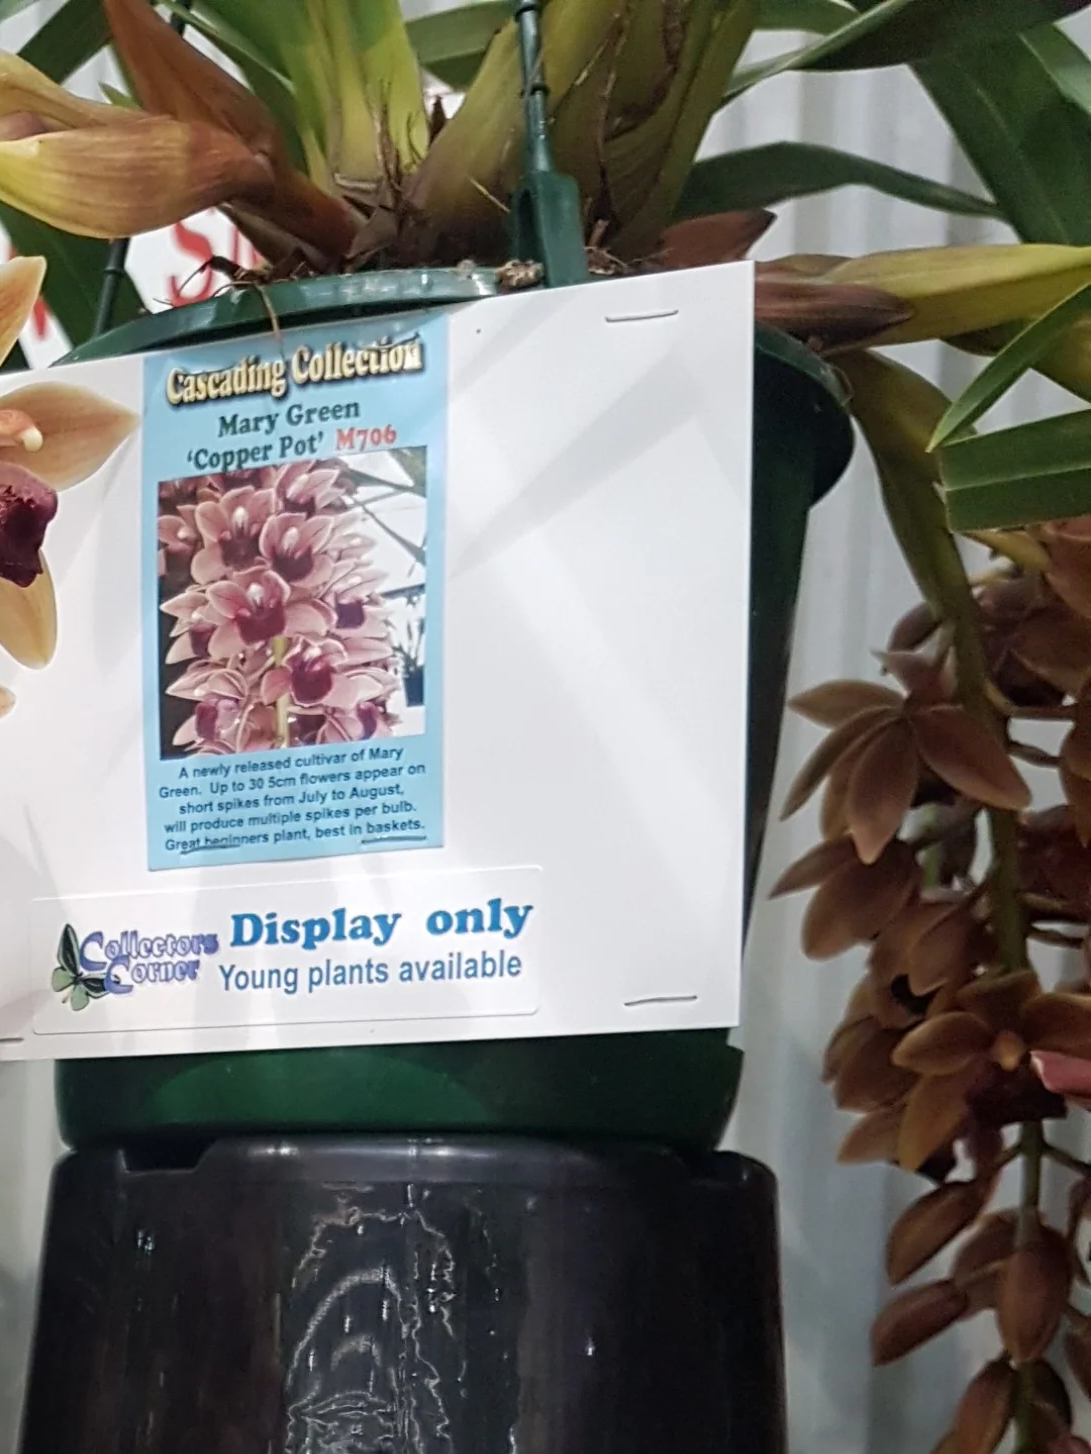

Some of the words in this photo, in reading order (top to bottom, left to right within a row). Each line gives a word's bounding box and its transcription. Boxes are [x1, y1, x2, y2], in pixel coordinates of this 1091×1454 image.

[166, 355, 288, 405] Cascading
[291, 337, 424, 384] Collection
[218, 410, 279, 438] Mary
[286, 401, 360, 427] Green
[336, 424, 397, 452] M706
[179, 767, 189, 779] A
[193, 763, 231, 778] newly
[234, 757, 291, 773] released
[295, 752, 347, 768] cultivar
[351, 748, 365, 762] of
[369, 747, 404, 761] Mary
[159, 785, 202, 799] Green.
[210, 782, 228, 796] Up
[232, 781, 245, 792] to
[249, 778, 264, 790] 30
[269, 775, 296, 788] 5cm
[300, 771, 351, 785] flowers
[355, 766, 403, 782] appear
[408, 764, 426, 775] on
[179, 801, 213, 815] short
[218, 798, 260, 813] spikes
[264, 794, 295, 807] from
[299, 790, 327, 805] July
[332, 789, 345, 800] to
[349, 783, 404, 800] August,
[164, 820, 186, 833] will
[191, 817, 244, 833] produce
[248, 811, 301, 825] multiple
[305, 807, 350, 823] spikes
[355, 805, 378, 819] per
[382, 800, 417, 814] bulb.
[165, 838, 200, 851] Great
[273, 828, 310, 844] plant,
[316, 825, 345, 839] best
[349, 823, 362, 835] in
[366, 819, 425, 833] baskets.
[230, 907, 401, 950] Display
[426, 898, 533, 939] only
[80, 930, 219, 972] Collectors
[104, 955, 201, 995] Corner
[219, 964, 298, 995] Young
[308, 959, 389, 994] plants
[399, 950, 522, 983] available
